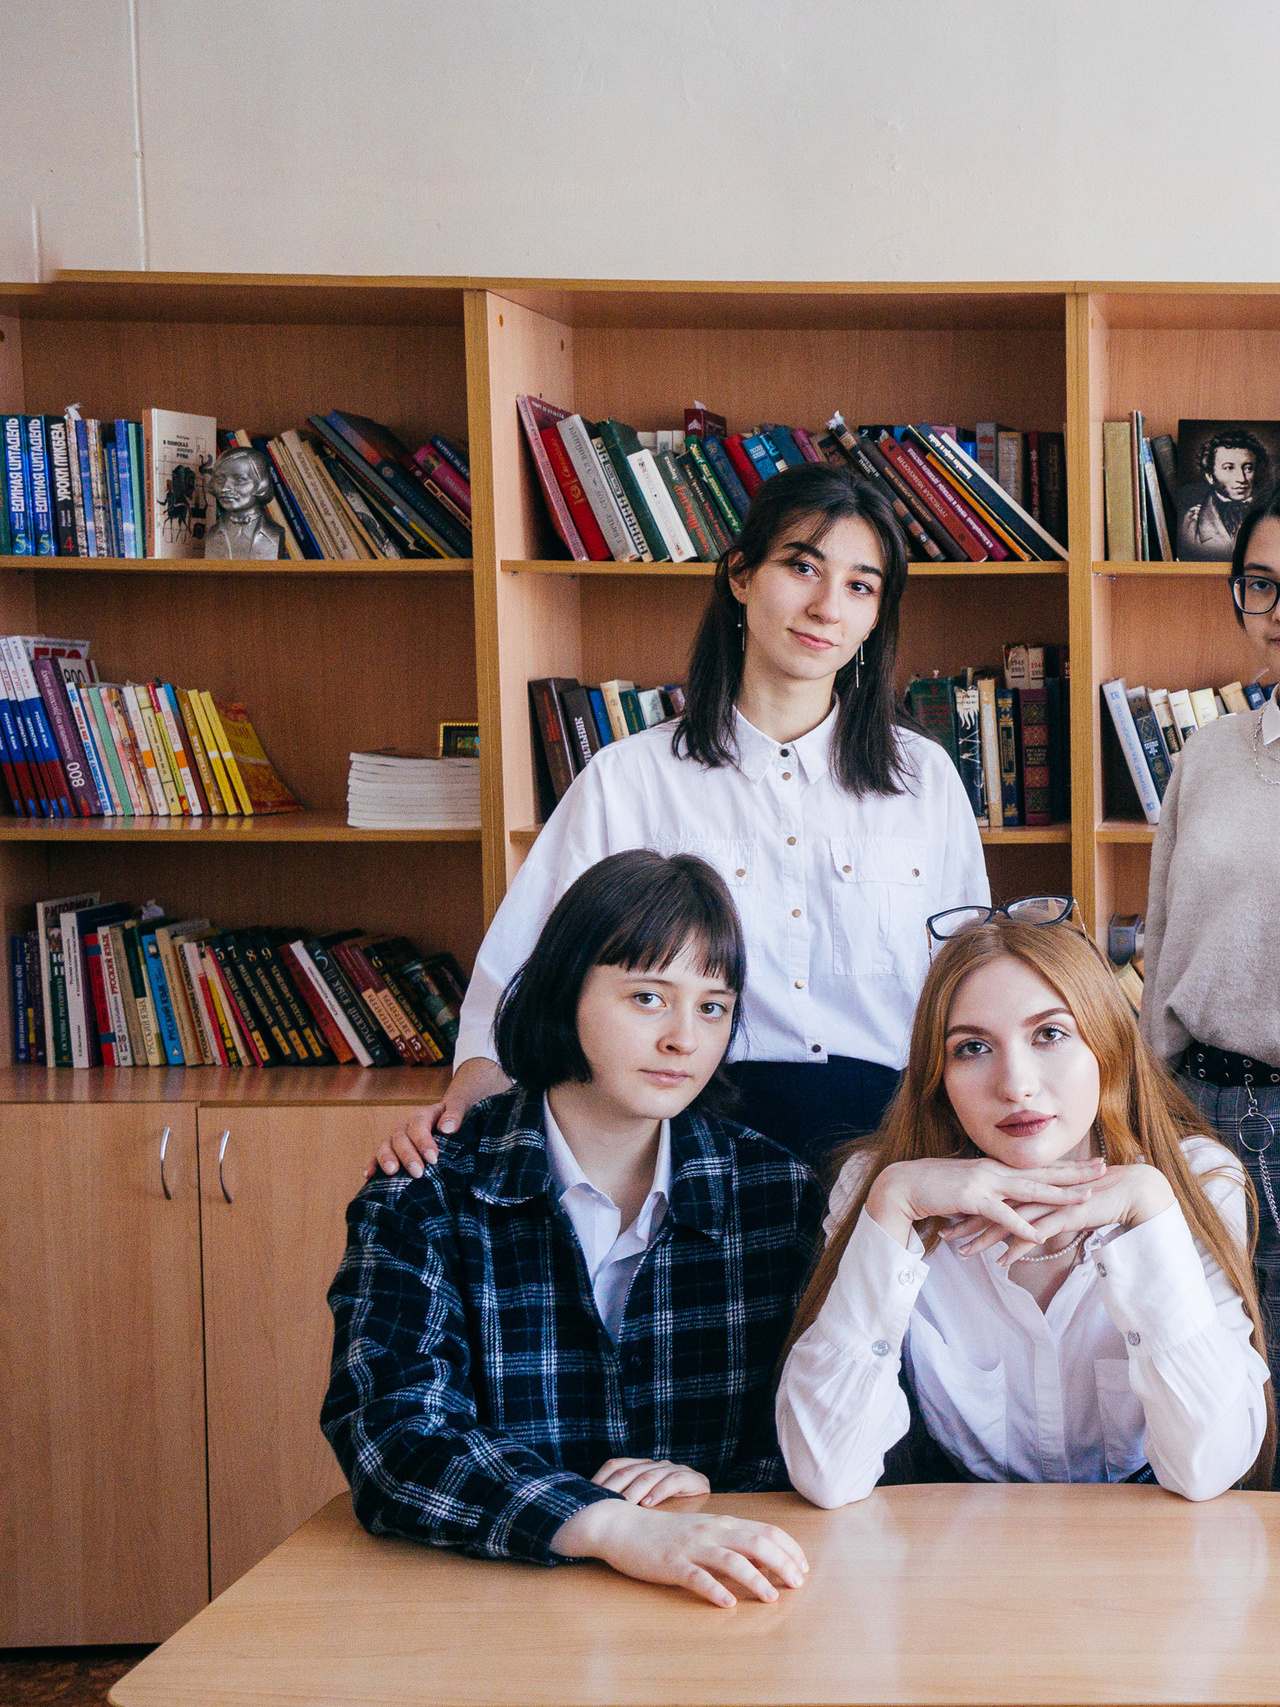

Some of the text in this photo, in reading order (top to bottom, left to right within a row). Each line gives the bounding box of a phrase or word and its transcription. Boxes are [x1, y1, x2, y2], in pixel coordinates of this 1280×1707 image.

[5, 418, 22, 471] ЦИТАДЕЛЬ
[28, 418, 44, 471] ЦИТАДЕЛЬ
[51, 422, 68, 466] ЛИКБЕЗА
[10, 472, 25, 512] ЕДИНАЯ
[33, 473, 48, 512] ЕДИНАЯ
[55, 467, 71, 501] УРОКИ
[894, 454, 948, 517] ГРЕЧЕСКАЯ МИФОЛОГИЯ
[910, 496, 933, 522] ЛИТЕРАТУРА
[15, 534, 26, 553] 5
[40, 534, 50, 554] 5
[63, 536, 74, 552] 4
[34, 710, 44, 732] РУССКИЙ
[573, 717, 594, 764] ИЛЬНЯК
[65, 760, 85, 788] 800
[101, 933, 111, 956] ЯЗЫК
[227, 945, 237, 959] 7
[246, 950, 257, 962] 8
[261, 947, 272, 960] 9
[104, 958, 118, 995] РУССКИЙ
[156, 984, 168, 1004] ЯЗЫК
[161, 1006, 177, 1041] РУССКИЙ
[331, 979, 375, 1044] РУССКИЙ ЯЗЫК
[366, 993, 395, 1035] ЛИТЕРАТУРА
[381, 993, 411, 1035] ЛИТЕРАТУРА
[144, 1020, 154, 1055] РУССКИЙ
